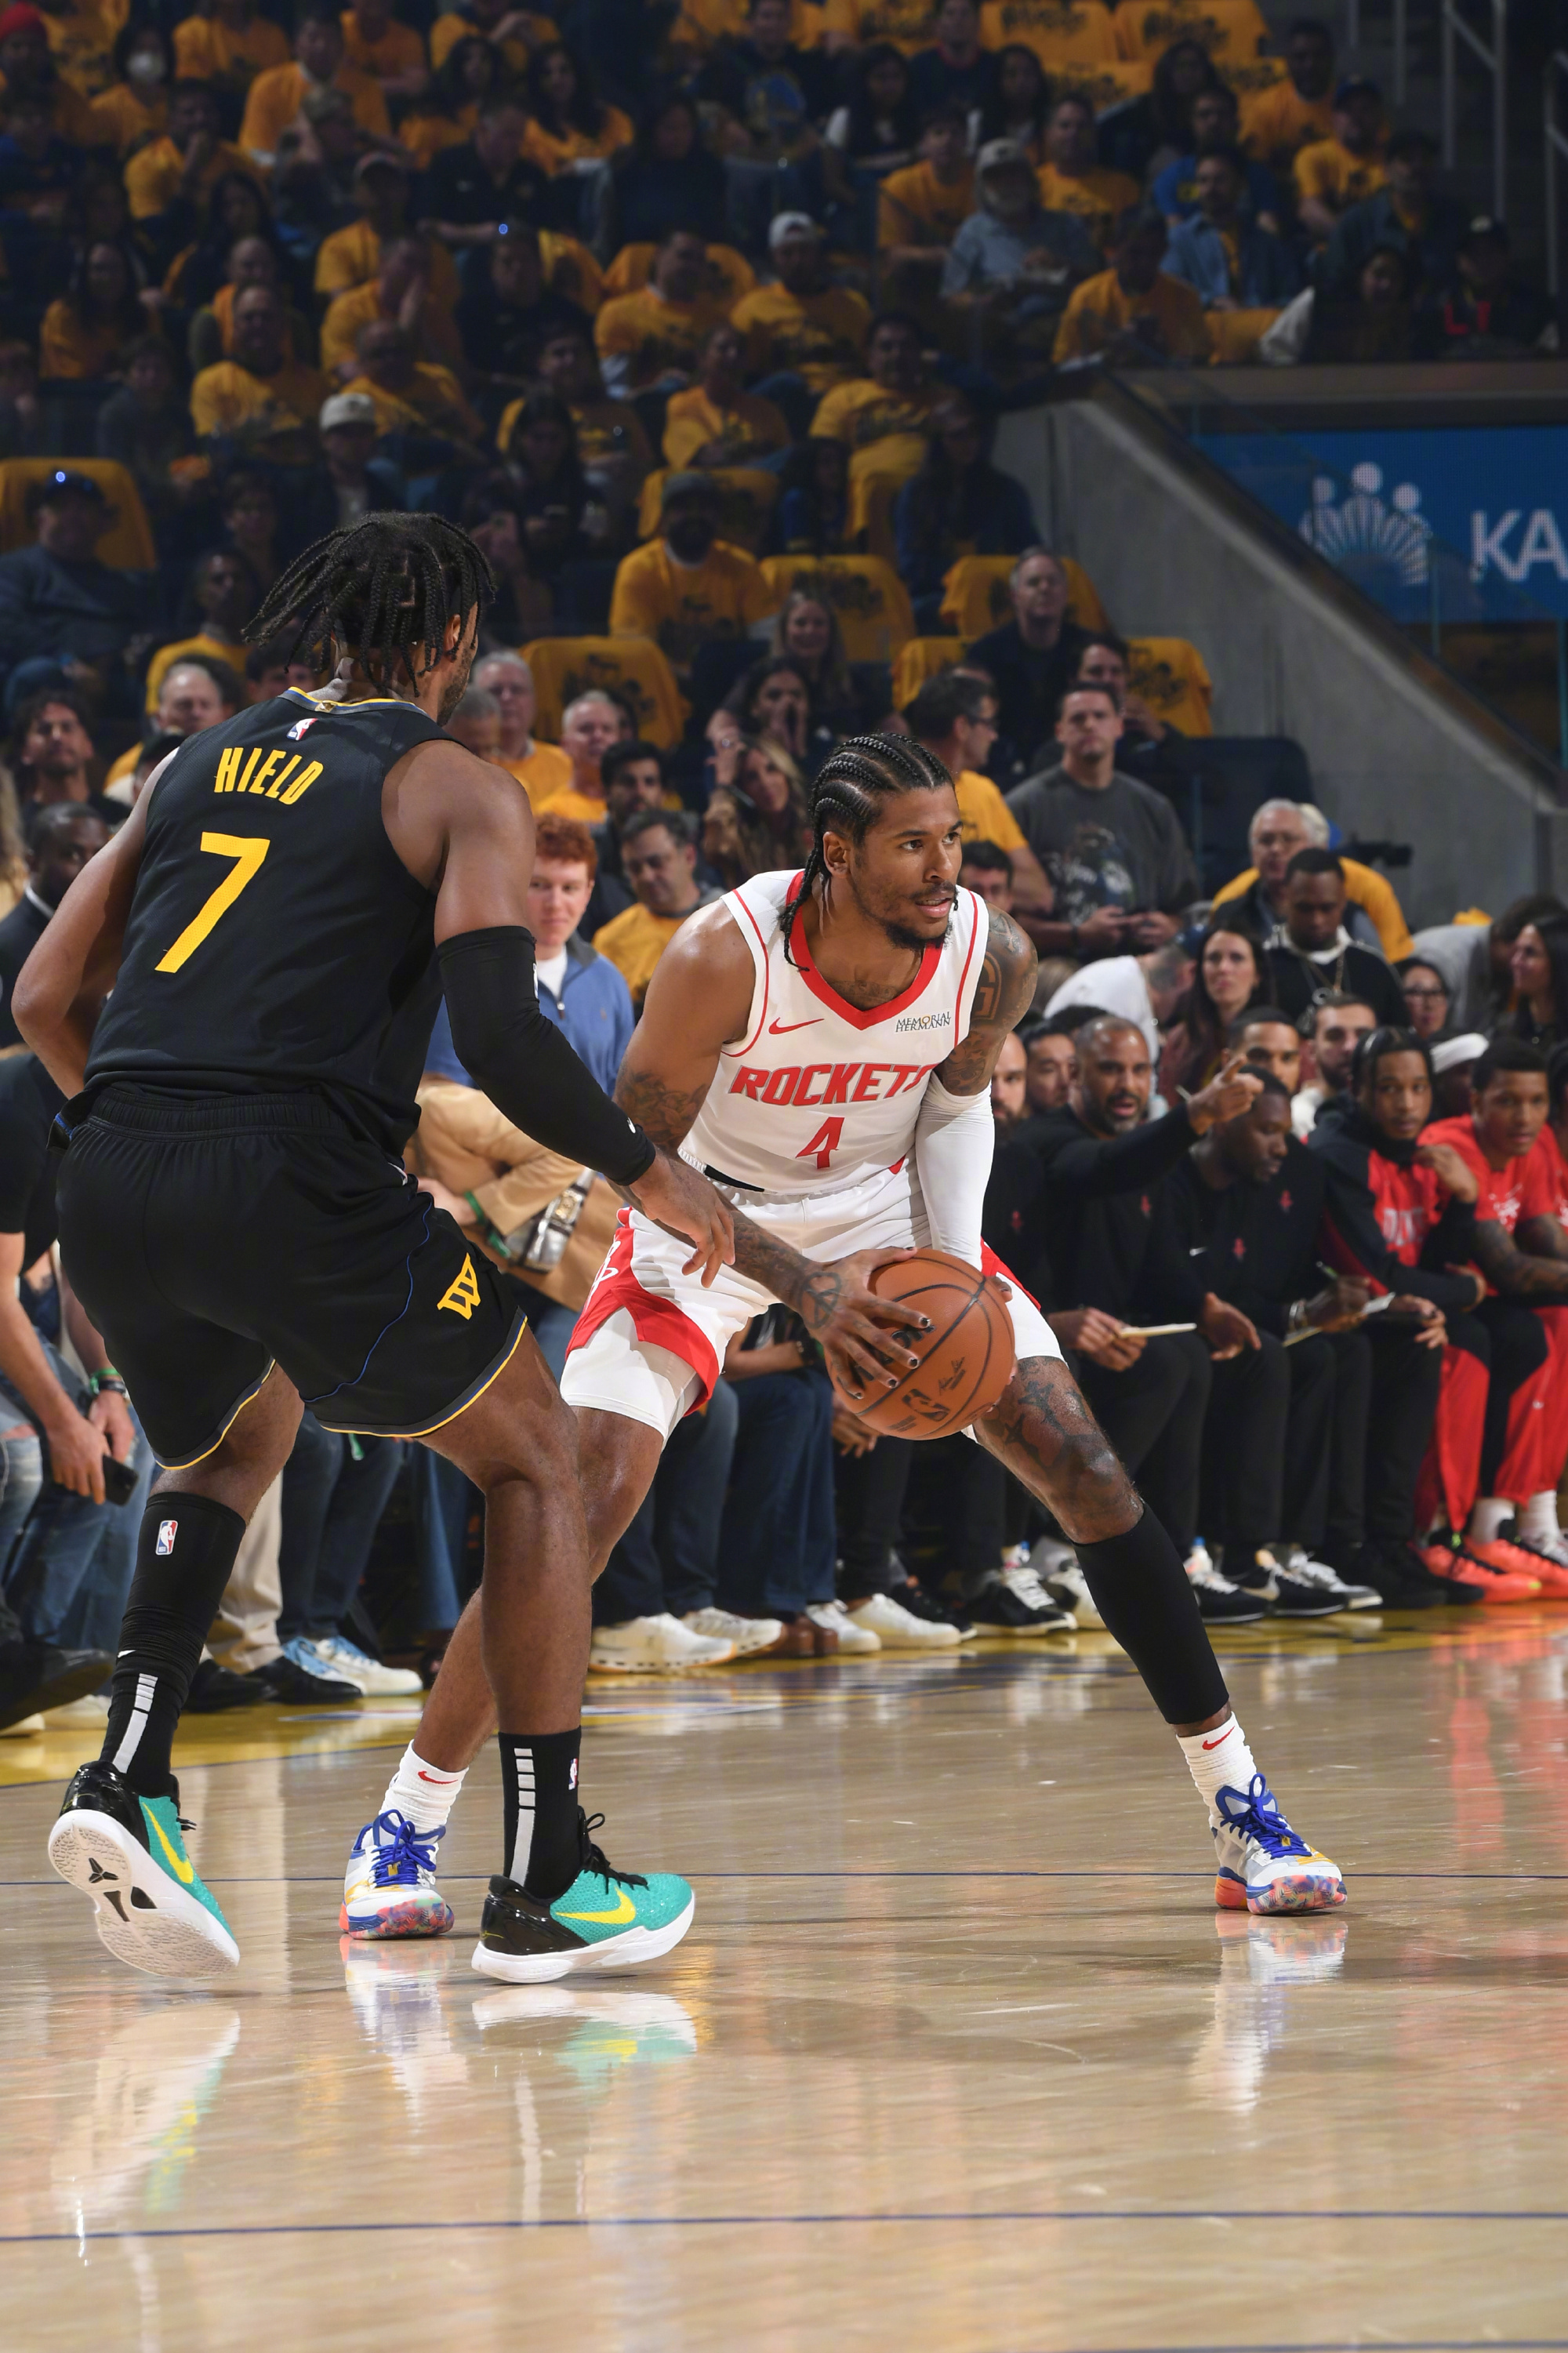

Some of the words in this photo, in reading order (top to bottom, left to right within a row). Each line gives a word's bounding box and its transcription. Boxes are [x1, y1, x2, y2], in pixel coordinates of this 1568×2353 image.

[213, 746, 325, 805] HIELD
[154, 831, 270, 973] 7
[895, 1017, 951, 1033] HERMANN
[897, 1011, 951, 1026] MEMORIAL
[795, 1117, 845, 1169] 4
